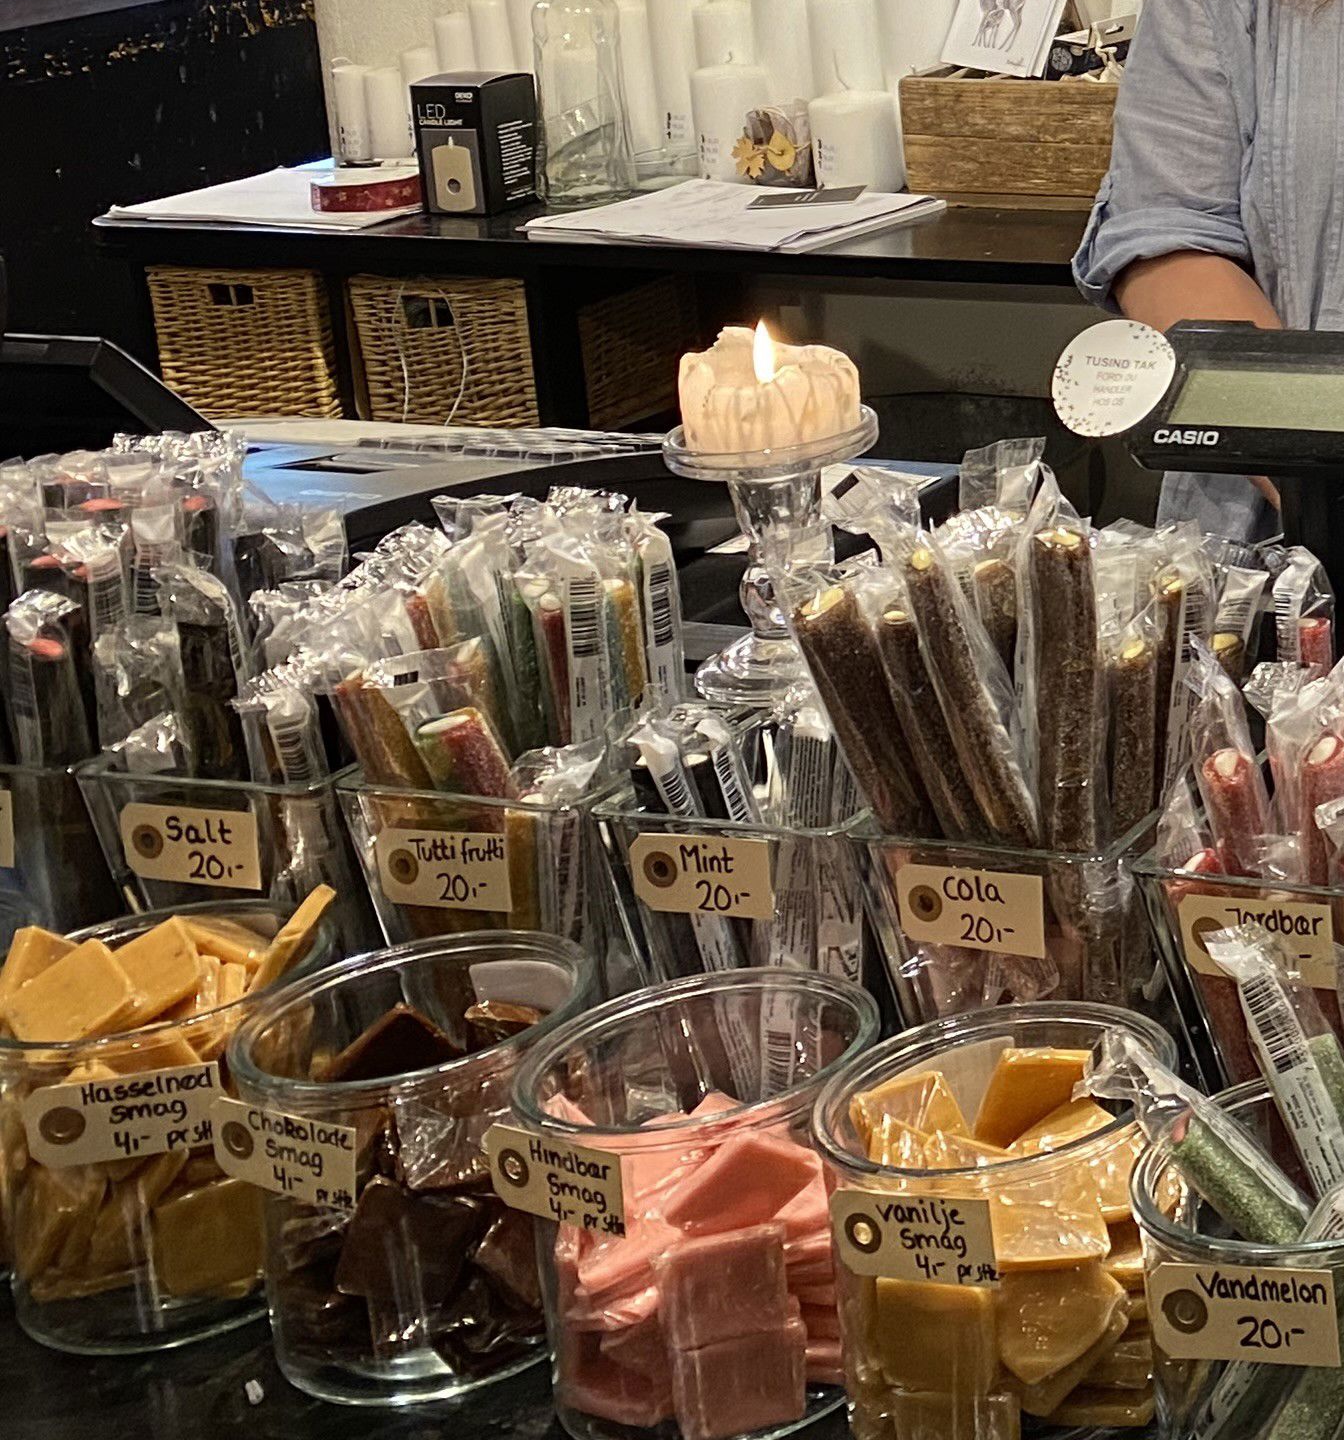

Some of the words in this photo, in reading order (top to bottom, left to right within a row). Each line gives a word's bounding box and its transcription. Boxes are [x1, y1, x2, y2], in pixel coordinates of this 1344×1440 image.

[417, 103, 446, 119] LED
[1086, 355, 1130, 369] TUSIND
[1134, 360, 1158, 370] TAK
[1153, 428, 1220, 446] CASIO
[165, 815, 232, 845] Salt
[408, 837, 456, 861] Tutti
[461, 838, 504, 863] frutti
[679, 844, 734, 875] Mint
[188, 851, 244, 880] 20,-
[436, 872, 487, 902] 20,-
[695, 879, 750, 912] 20,-
[961, 913, 1015, 944] 20,-
[1195, 1271, 1328, 1305] Vandmelon
[1237, 1315, 1305, 1349] 20,-
